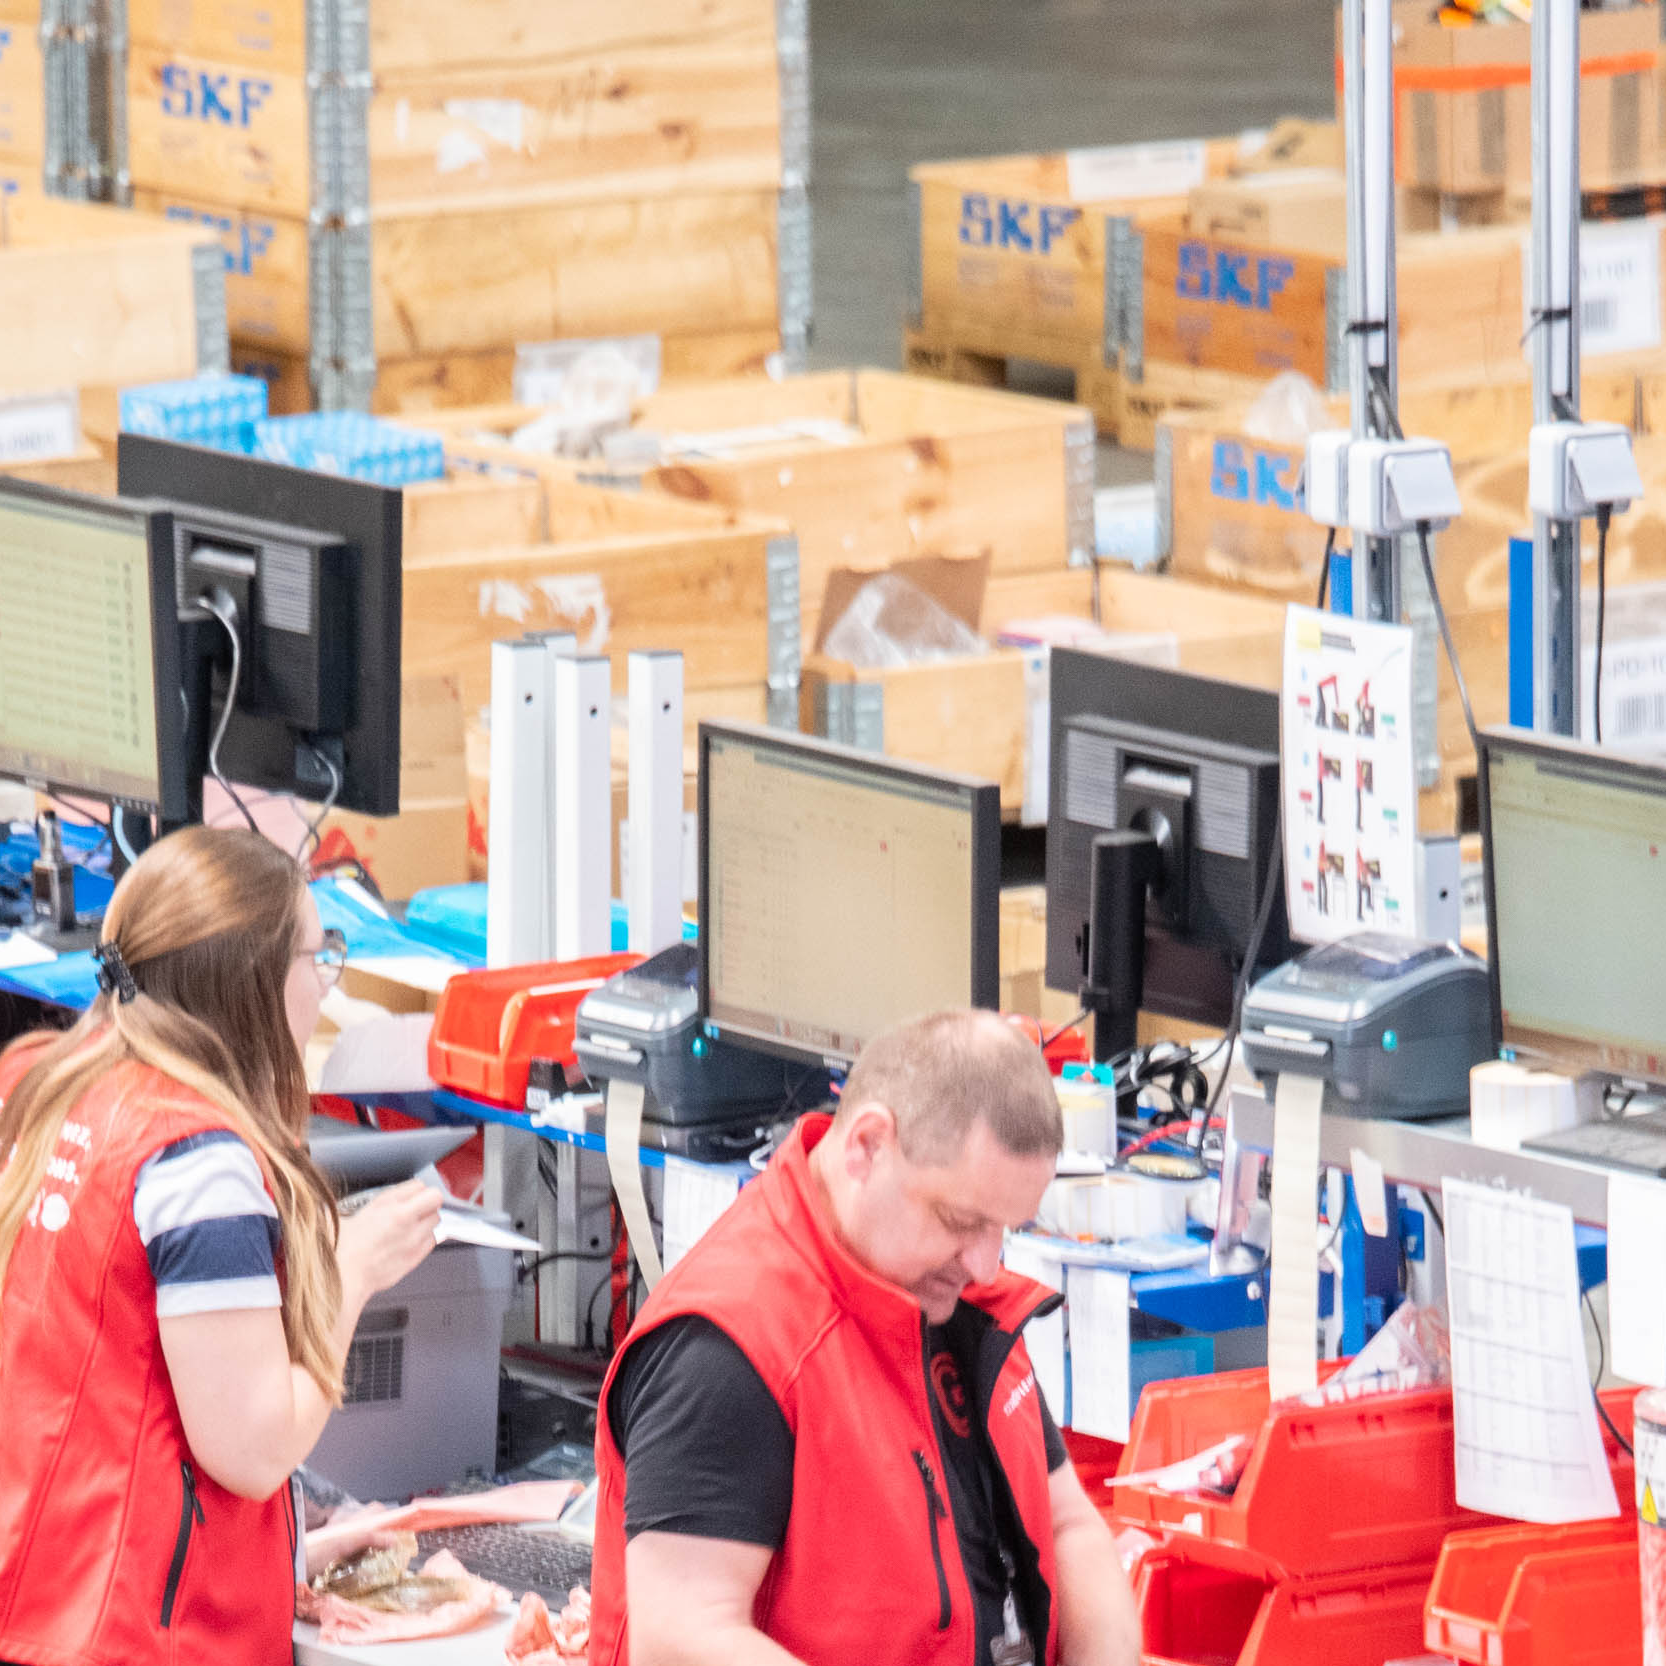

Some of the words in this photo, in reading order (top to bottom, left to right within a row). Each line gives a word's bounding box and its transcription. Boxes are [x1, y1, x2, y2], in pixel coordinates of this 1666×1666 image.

[161, 62, 272, 128] SKF
[960, 193, 1074, 255] SKF
[1176, 238, 1295, 312] SKF
[1210, 439, 1307, 512] SK
